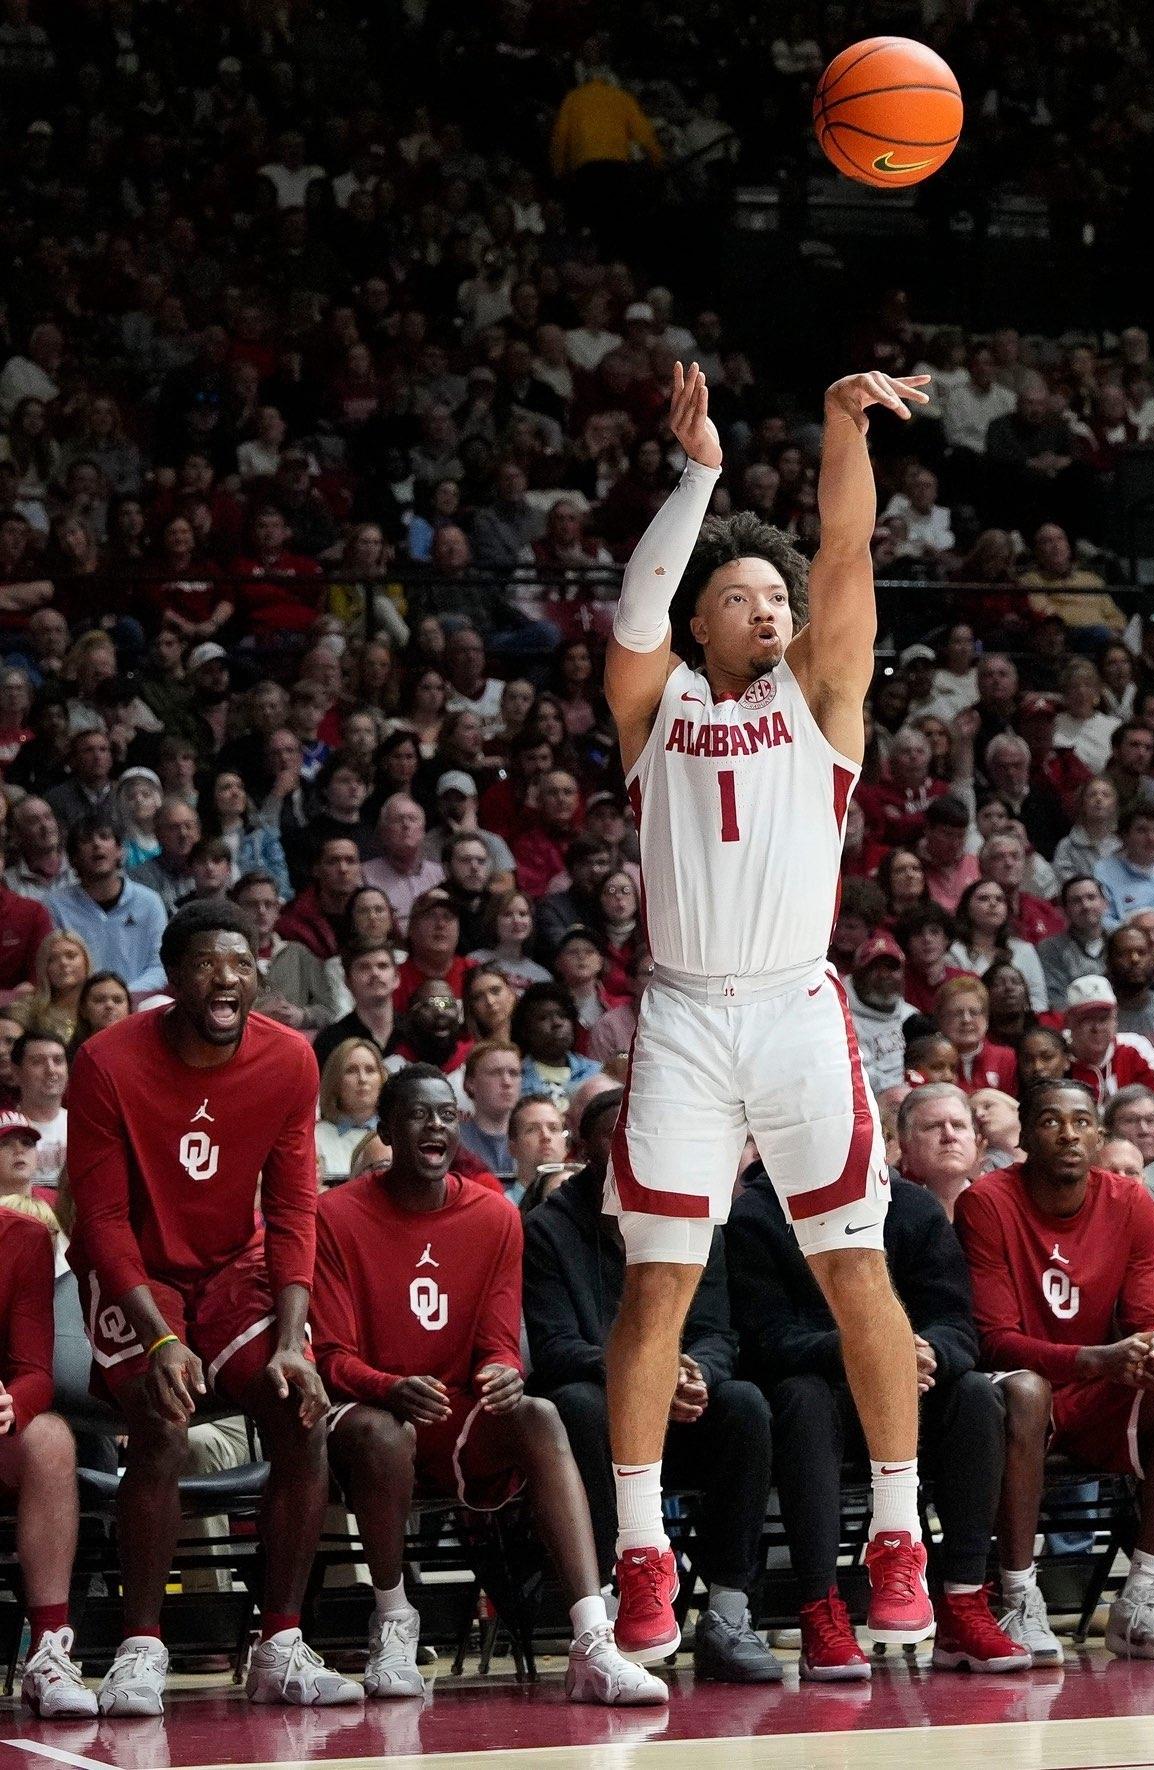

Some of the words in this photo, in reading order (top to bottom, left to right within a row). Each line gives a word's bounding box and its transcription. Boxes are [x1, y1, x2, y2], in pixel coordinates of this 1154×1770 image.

[745, 680, 772, 703] SEC
[665, 711, 793, 757] ALABAMA
[717, 770, 740, 842] 1
[179, 1131, 220, 1181] OU
[409, 1277, 448, 1330] OU
[1042, 1268, 1080, 1319] OU
[99, 1305, 136, 1343] OU
